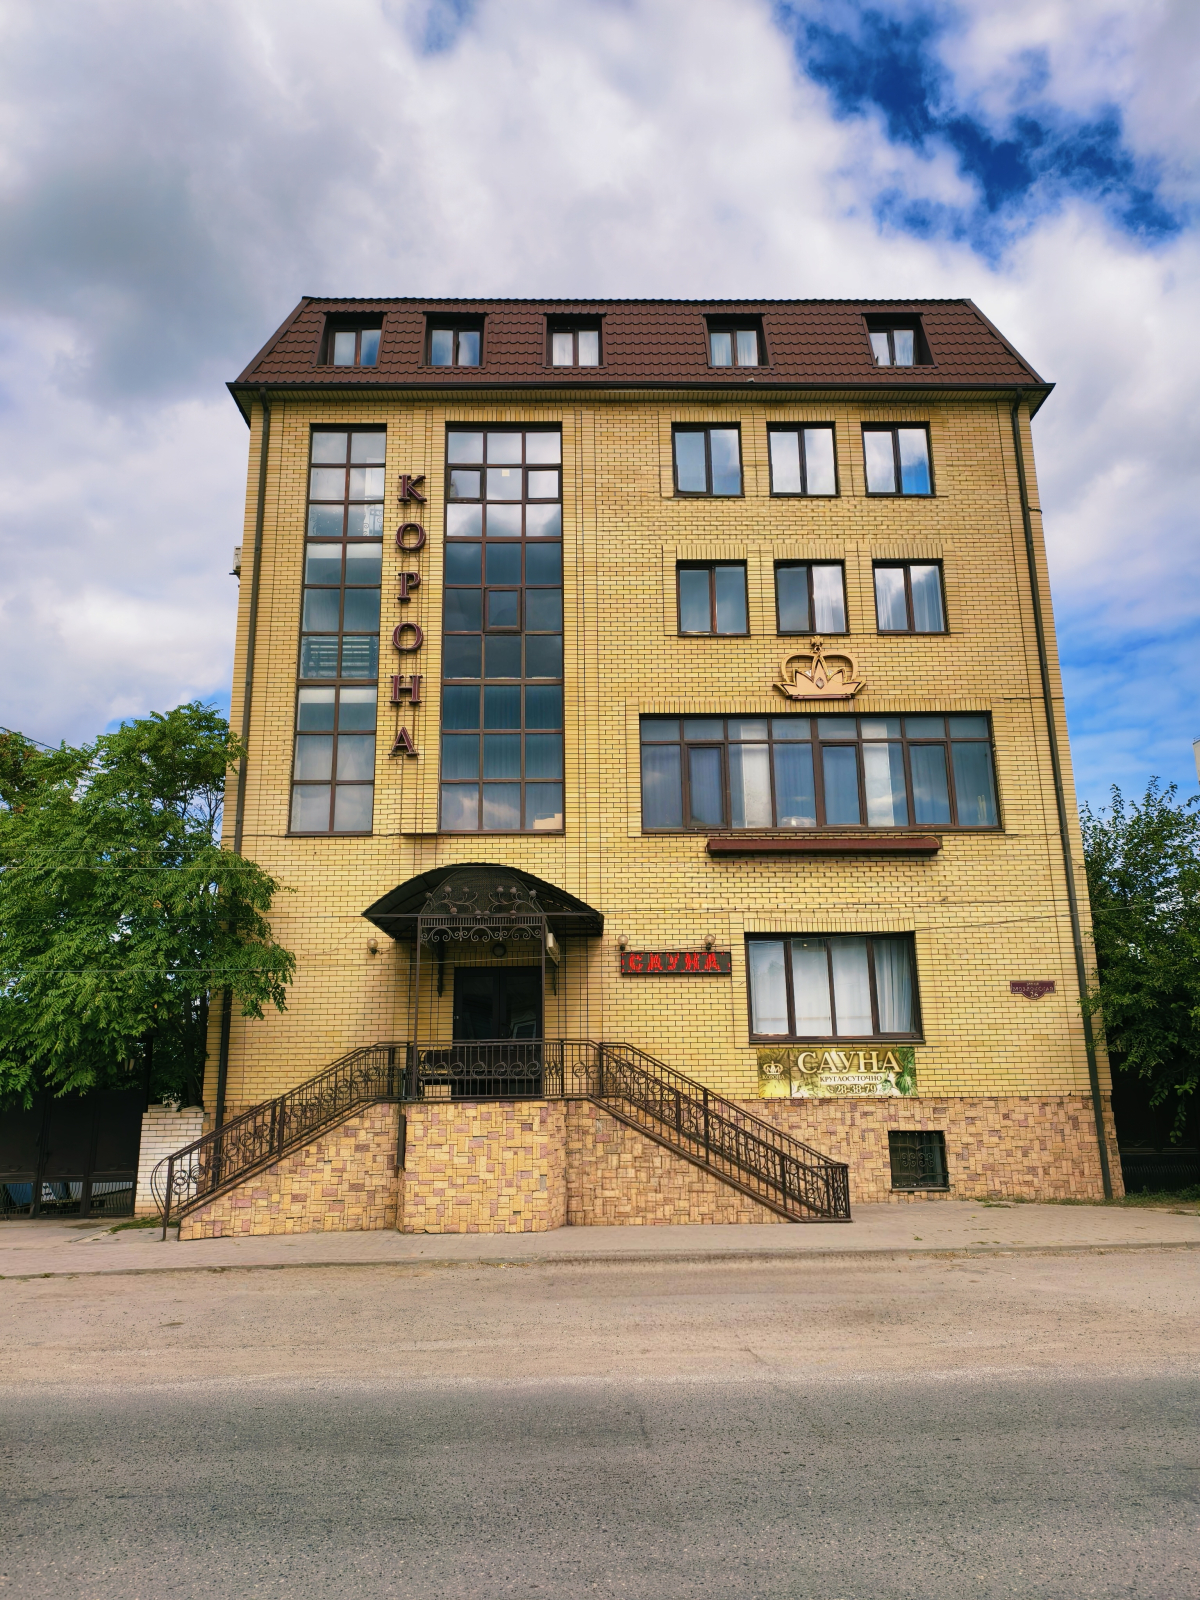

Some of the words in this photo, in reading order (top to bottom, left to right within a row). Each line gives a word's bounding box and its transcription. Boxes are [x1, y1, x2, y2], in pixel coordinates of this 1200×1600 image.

[389, 474, 428, 758] КОРОНА
[628, 952, 721, 972] САУНА
[797, 1051, 903, 1073] САУНА
[820, 1075, 883, 1083] КРУГЛОСУТОЧНО
[835, 1084, 877, 1094] 28-38-79
